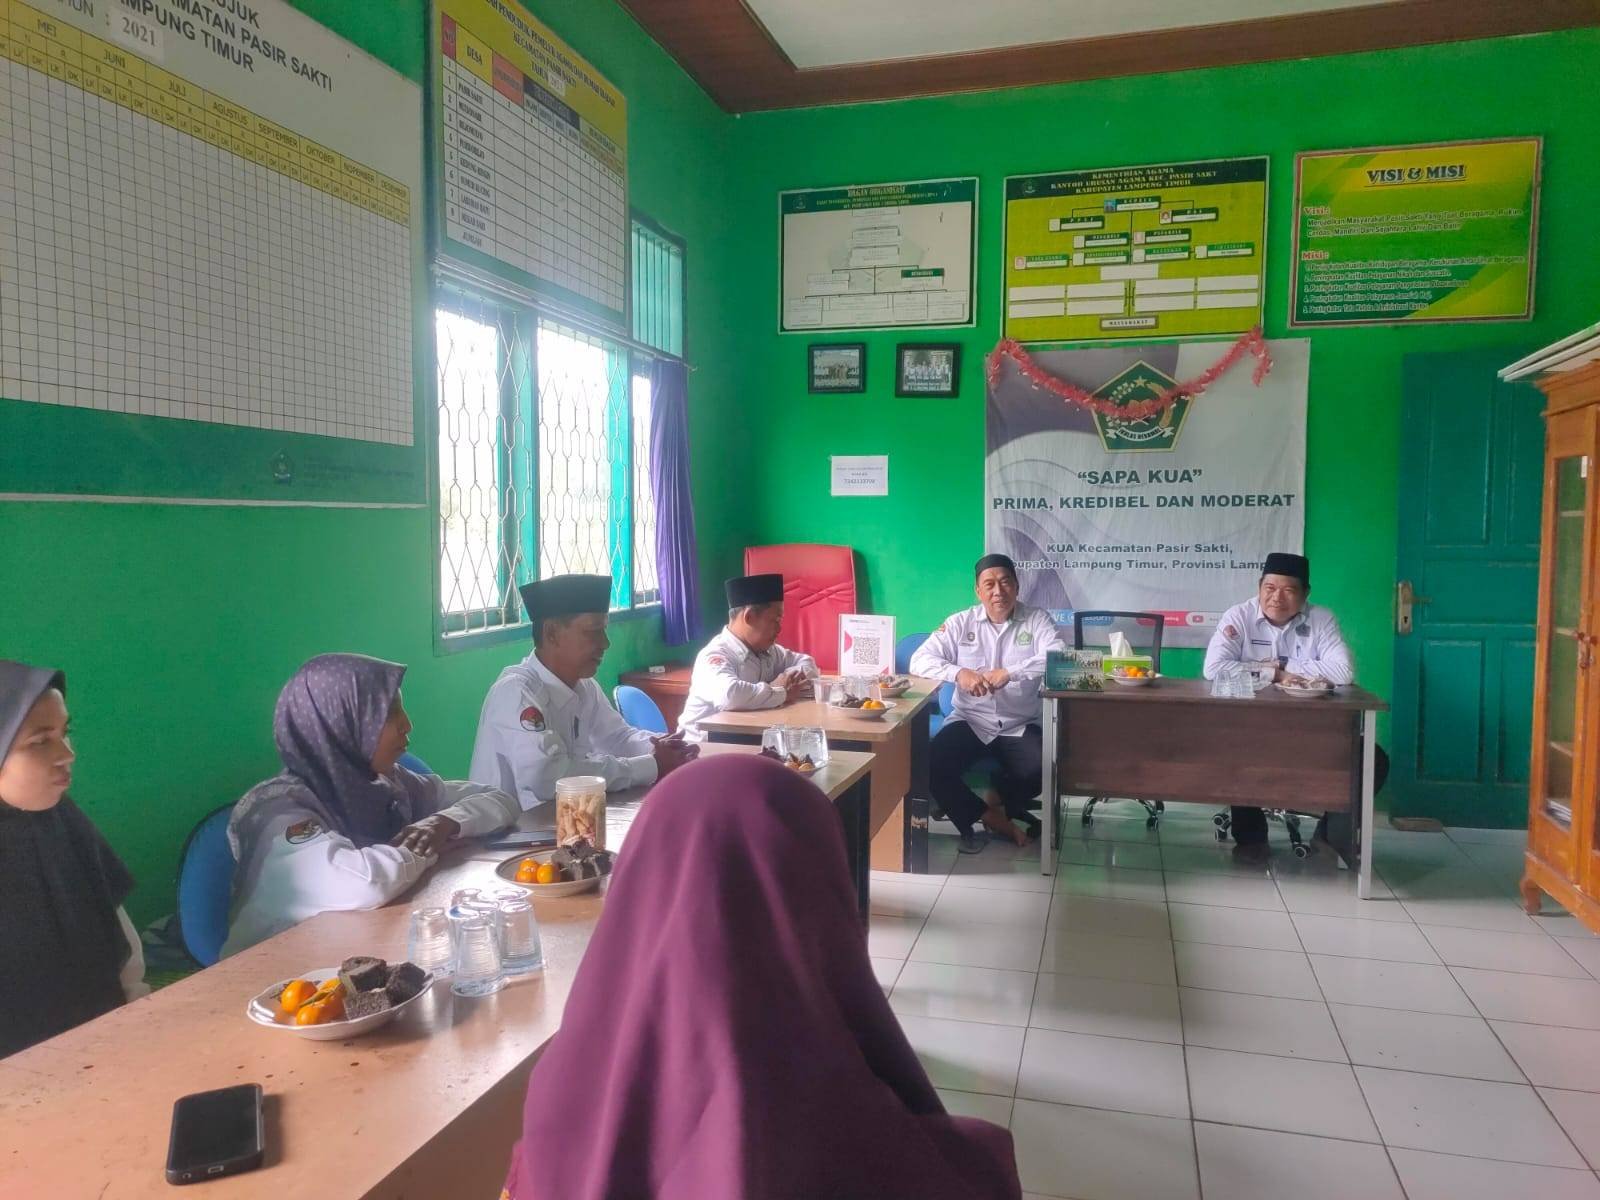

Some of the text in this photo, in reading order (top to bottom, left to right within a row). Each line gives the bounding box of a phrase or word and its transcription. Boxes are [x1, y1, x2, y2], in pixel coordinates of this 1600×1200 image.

[121, 16, 156, 47] 2021
[200, 29, 255, 73] TIMUR
[241, 27, 288, 68] PASIR
[291, 56, 333, 92] SAKTI
[466, 46, 483, 65] DESA
[37, 18, 57, 38] MEI
[103, 49, 126, 68] JUNI
[168, 80, 186, 97] JULI
[212, 101, 249, 126] AGUSTUS
[258, 122, 298, 148] SEPTEMBER
[306, 144, 335, 165] OKTOBER
[1145, 167, 1174, 176] AGAMA
[1366, 164, 1466, 183] VISI & MISI
[1050, 181, 1084, 190] KANTOR
[1085, 178, 1115, 187] URUSAN
[1117, 176, 1146, 184] AGAMA
[1169, 173, 1194, 181] PASIR
[1075, 179, 1192, 194] KABUPATEN LAMPUNG TIMUR
[1303, 206, 1331, 216] Visi:
[1301, 250, 1330, 260] Misi:
[993, 494, 1296, 511] PRIMA, KREDIBEL DAN MODERAT
[1047, 543, 1234, 556] KUA Kecamatan Pasir Sakti,
[1012, 559, 1266, 571] upaten Lampung Timur, Provinsi Lamp
